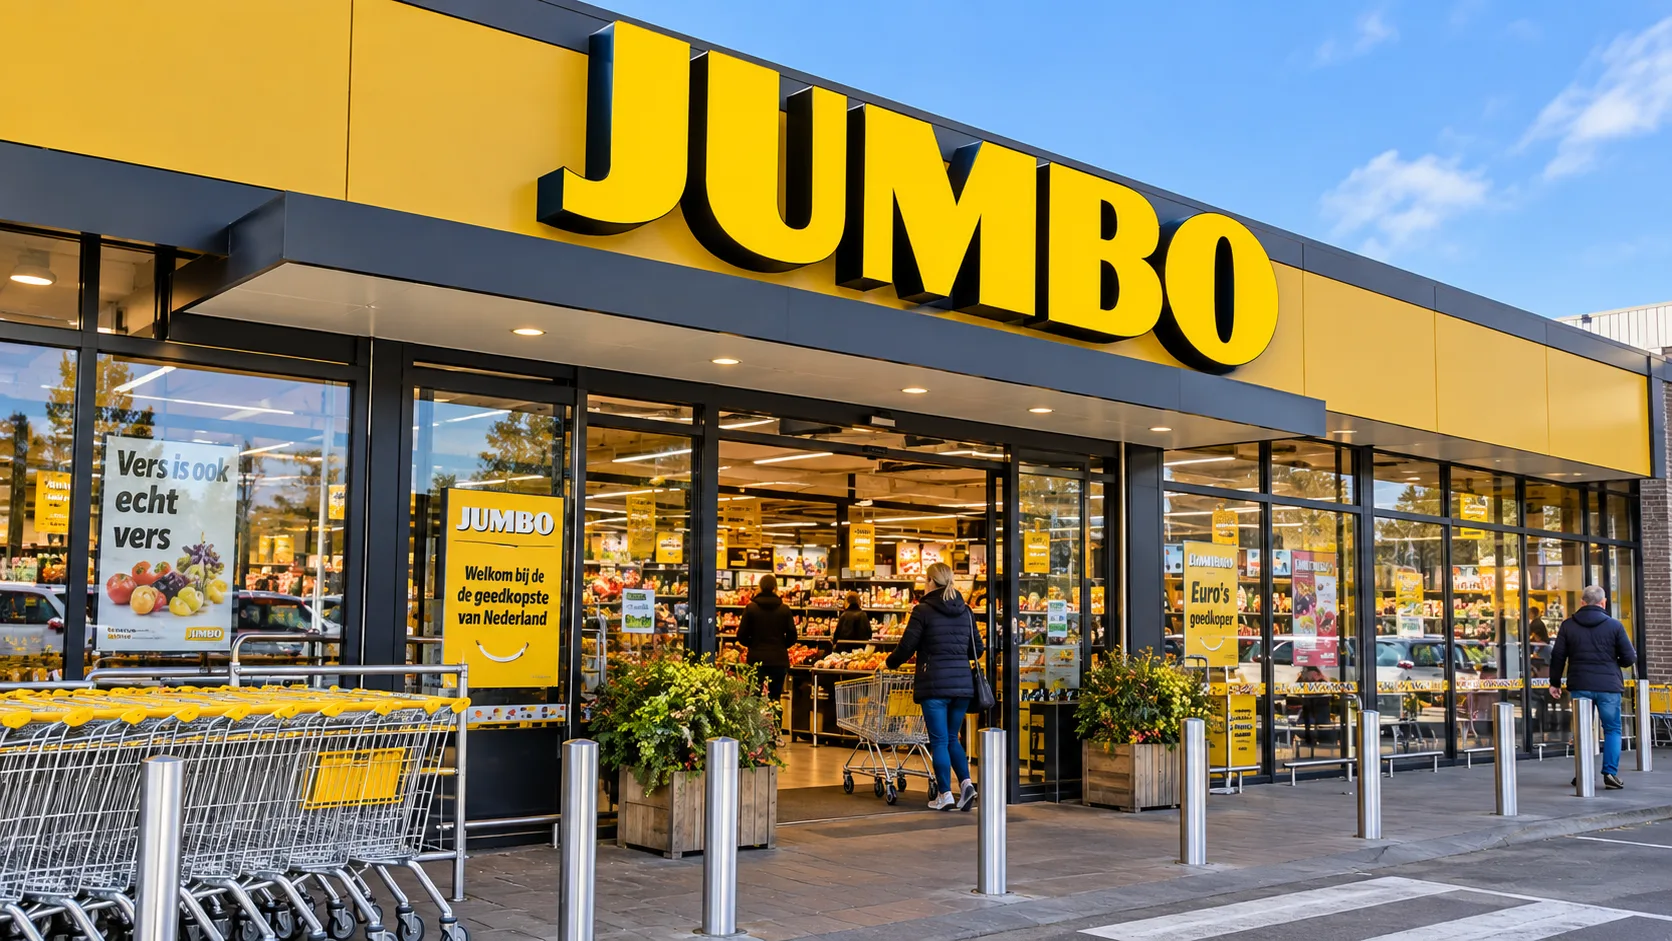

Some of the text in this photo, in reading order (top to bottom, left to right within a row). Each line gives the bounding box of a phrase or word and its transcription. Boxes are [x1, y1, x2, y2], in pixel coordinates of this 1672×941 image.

[539, 20, 1279, 371] JUMBO
[117, 449, 230, 482] Vers is ook
[115, 485, 179, 514] echt
[456, 506, 555, 536] JUMBO
[113, 526, 171, 550] vers
[465, 565, 545, 585] Welkom bij de
[457, 586, 549, 608] de geedkopste
[1191, 581, 1230, 604] Euro's
[458, 609, 548, 626] van Nederland
[1190, 609, 1234, 629] goedkoper
